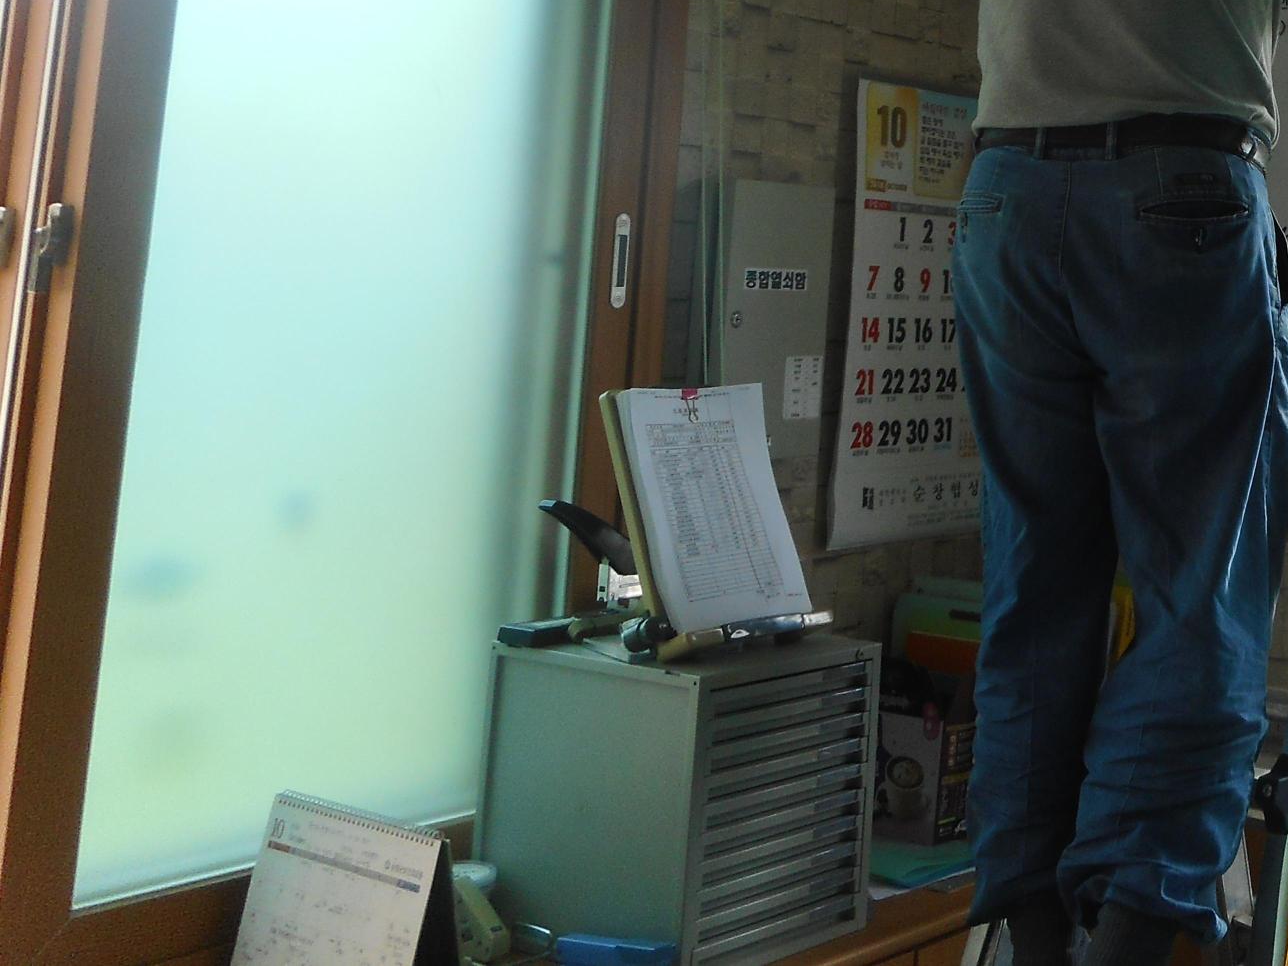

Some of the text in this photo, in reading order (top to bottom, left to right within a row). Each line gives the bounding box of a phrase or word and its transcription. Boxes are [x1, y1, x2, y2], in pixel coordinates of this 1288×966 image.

[877, 105, 907, 148] 10
[899, 217, 906, 242] 1
[923, 218, 934, 244] 2
[745, 270, 807, 290] 종합열쇠함
[867, 265, 955, 294] 7 8 9 1
[861, 317, 956, 343] 14 15 16 17
[855, 367, 957, 396] 21 22 23 24
[850, 417, 953, 449] 28 29 30 31
